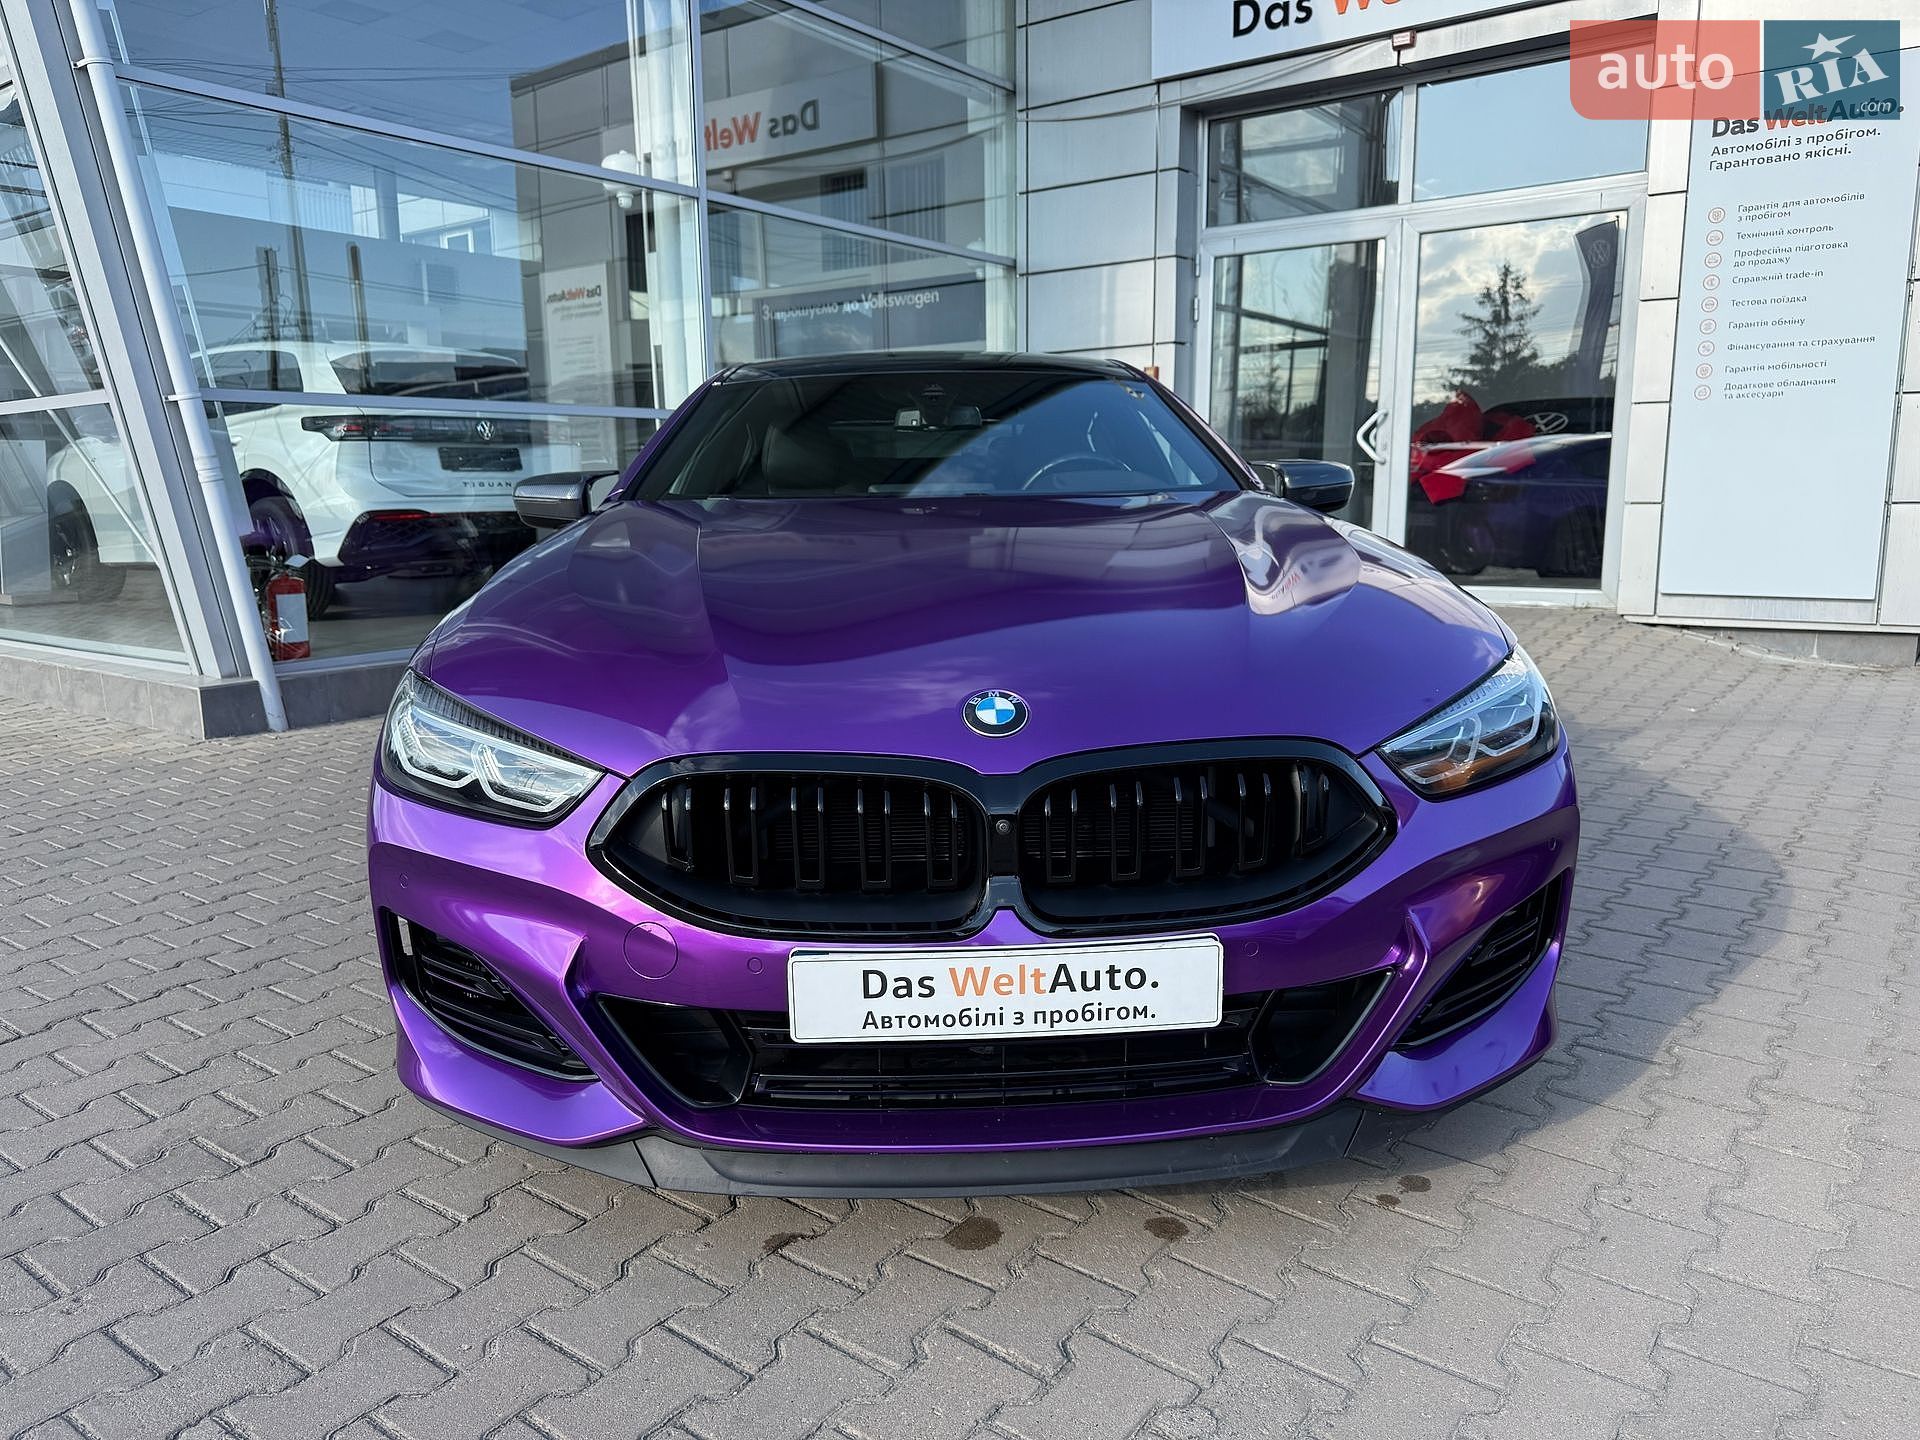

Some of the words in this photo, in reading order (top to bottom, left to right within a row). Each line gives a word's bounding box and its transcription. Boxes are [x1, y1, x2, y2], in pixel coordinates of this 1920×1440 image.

[1233, 0, 1313, 38] Das
[1711, 116, 1760, 137] Das
[1711, 136, 1791, 157] Автомобілі
[1795, 137, 1802, 146] з
[1806, 127, 1881, 145] пробігом.
[1709, 151, 1801, 172] Гарантовано
[1805, 144, 1852, 159] якісні.
[1737, 202, 1779, 214] Гарантія
[1782, 200, 1801, 209] для
[1803, 192, 1865, 206] автомобілів
[1745, 210, 1791, 222] пробігом
[1736, 228, 1784, 240] Технічний
[1787, 224, 1834, 235] контроль
[1734, 246, 1792, 259] Професійна
[1795, 241, 1849, 253] підготовка
[1733, 259, 1745, 268] до
[1748, 256, 1791, 267] продажу
[1786, 269, 1824, 280] trade-in
[842, 301, 859, 314] до
[861, 290, 940, 309] Volkswagen
[1730, 297, 1767, 307] Тестова
[1770, 295, 1807, 305] поїздка
[1728, 320, 1769, 331] Гарантія
[1771, 317, 1806, 328] обміну
[1727, 340, 1795, 352] Фінансування
[1811, 335, 1876, 348] страхування
[1724, 364, 1765, 375] Гарантія
[1767, 360, 1827, 372] мобільності
[1724, 382, 1775, 392] Додаткове
[1777, 378, 1837, 388] обладнання
[969, 691, 1021, 706] BMW
[862, 968, 935, 999] Das
[948, 963, 1160, 998] WeltAuto.
[861, 1007, 1004, 1030] Автомобілі
[1013, 1010, 1025, 1026] з
[1034, 1002, 1157, 1028] пробігом.
